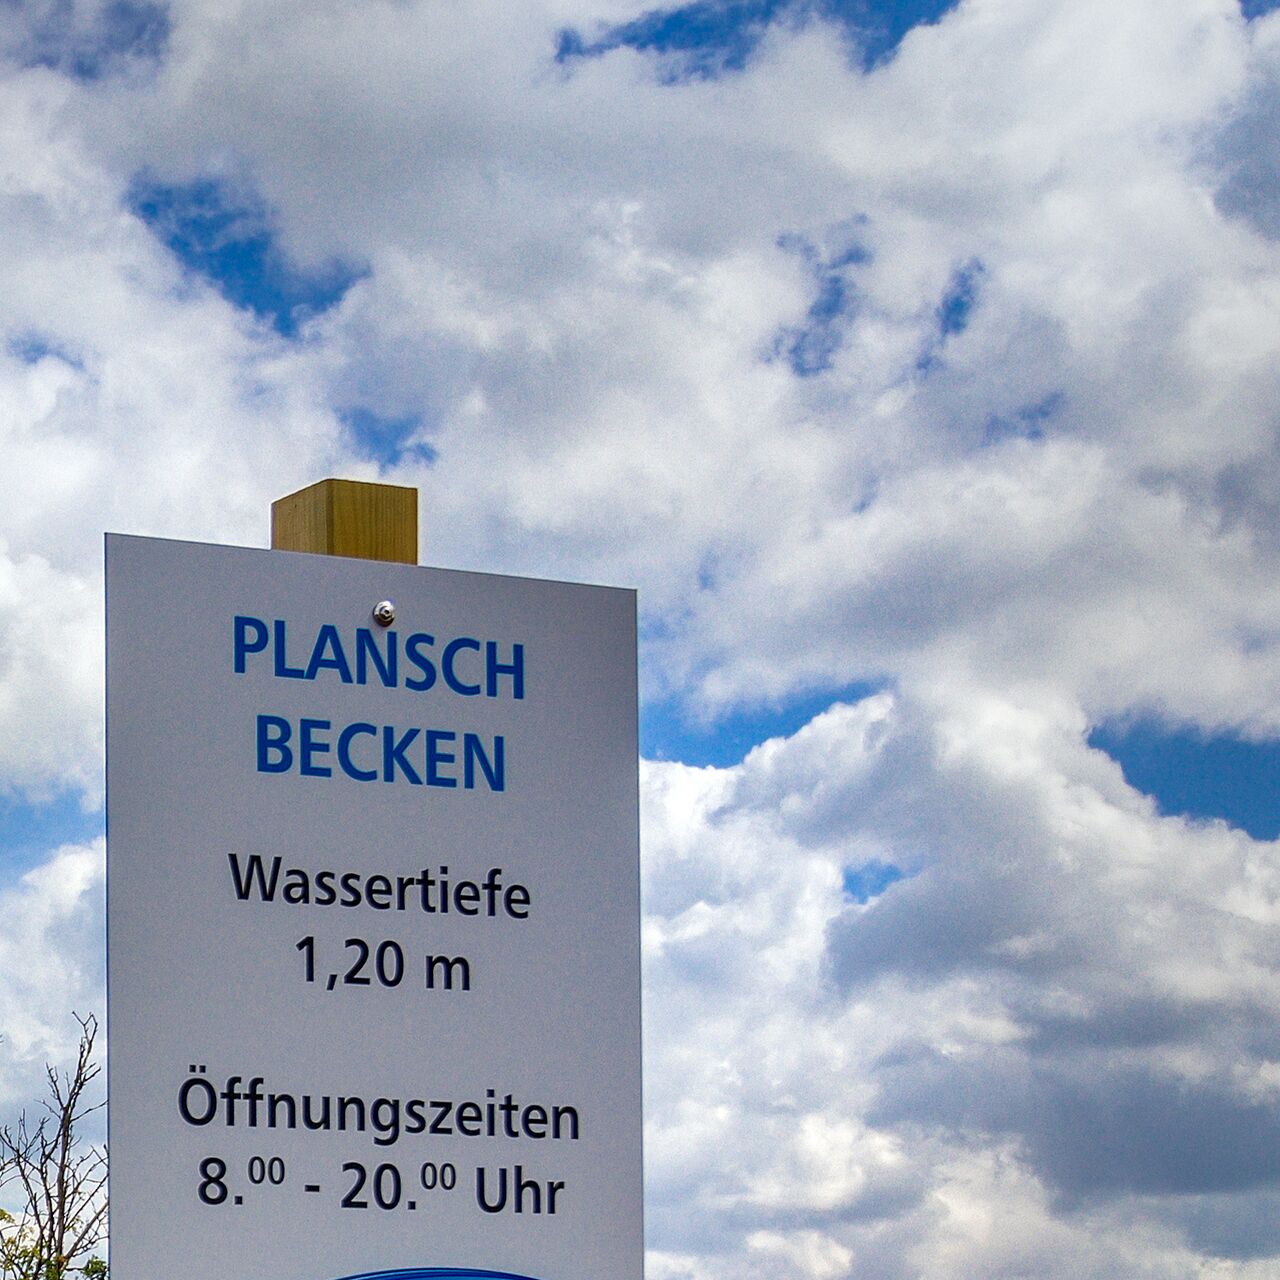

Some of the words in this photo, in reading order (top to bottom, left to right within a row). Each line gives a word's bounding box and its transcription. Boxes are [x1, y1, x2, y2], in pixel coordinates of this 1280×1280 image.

[233, 615, 525, 700] PLANSCH
[256, 714, 506, 792] BECKEN
[227, 853, 531, 919] Wassertiefe
[295, 936, 405, 991] 1,20
[426, 953, 470, 991] m
[178, 1064, 580, 1146] Öffnungszeiten
[475, 1166, 565, 1214] Uhr
